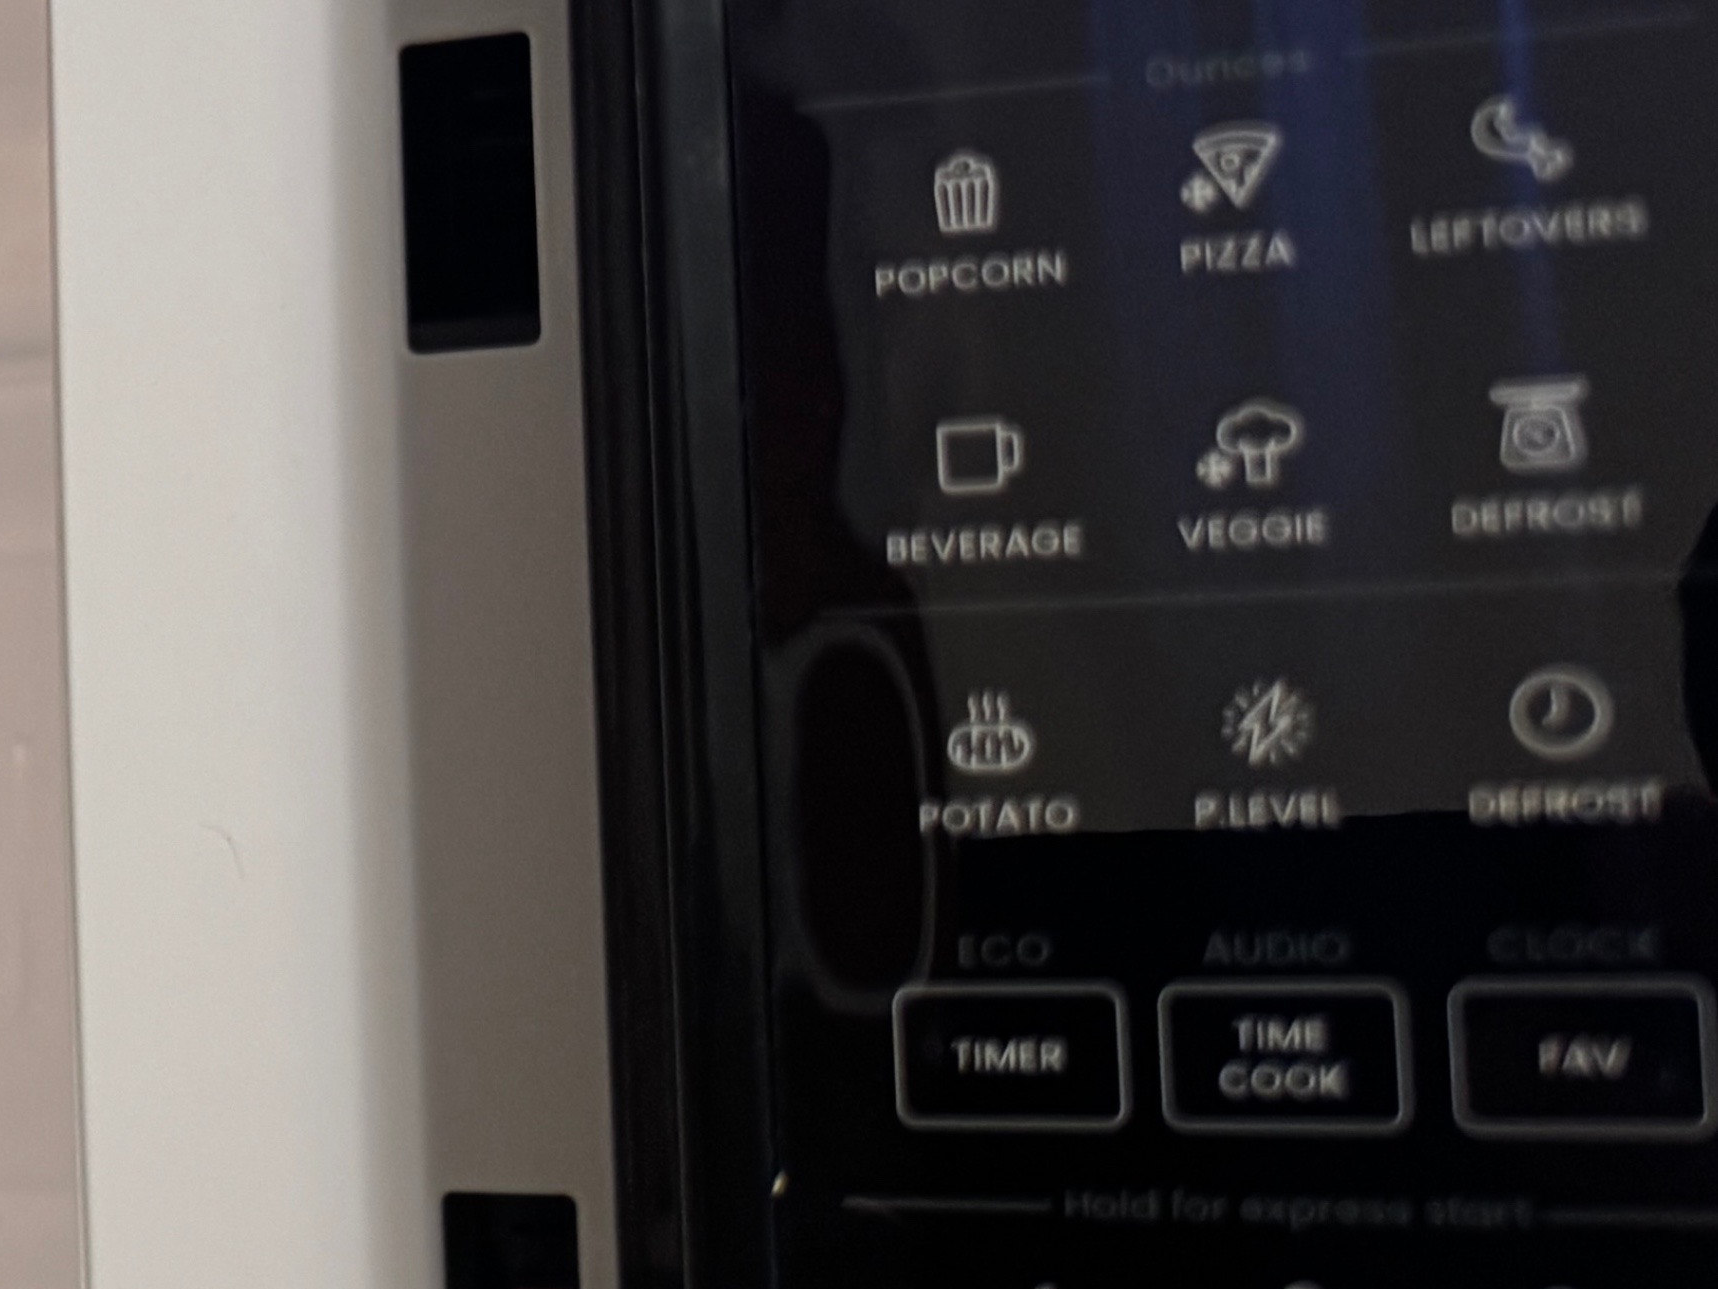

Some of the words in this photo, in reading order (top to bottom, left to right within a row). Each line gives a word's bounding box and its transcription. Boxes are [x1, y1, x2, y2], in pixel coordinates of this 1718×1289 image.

[1409, 198, 1649, 255] LEFTOVERS
[1179, 233, 1296, 273] PIZZA
[874, 250, 1068, 297] POPCORN
[1176, 511, 1329, 550] VEGGIE
[1449, 485, 1643, 537] DEFROST
[885, 522, 1083, 565] BEVERAGE
[917, 795, 1078, 834] POTATO
[1194, 792, 1344, 831] P.LEVEL
[1468, 780, 1666, 830] DEFROST
[956, 931, 1053, 968] ECO
[1202, 929, 1354, 966] AUDIO
[1485, 921, 1664, 964] CLOCK
[1230, 1013, 1332, 1053] TIME
[949, 1035, 1070, 1074] TIMER
[1535, 1033, 1634, 1080] FAV
[1217, 1061, 1350, 1102] COOK
